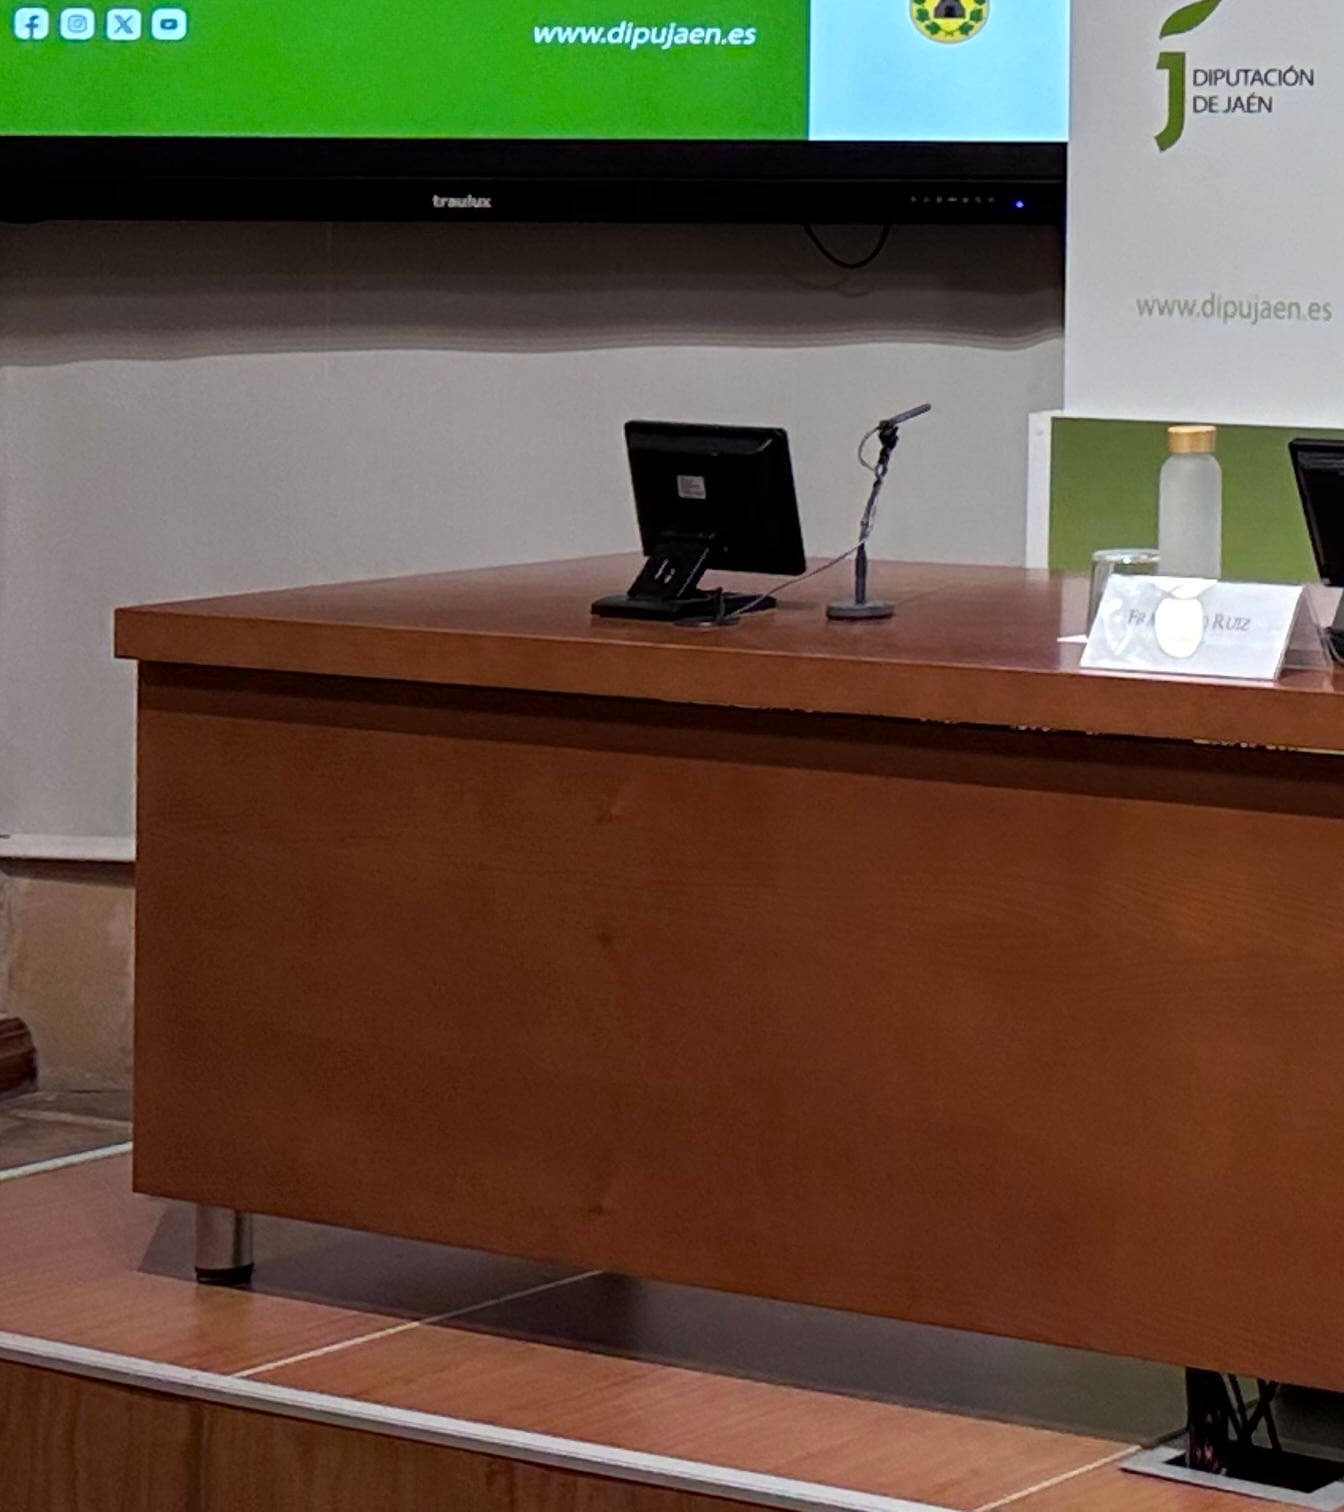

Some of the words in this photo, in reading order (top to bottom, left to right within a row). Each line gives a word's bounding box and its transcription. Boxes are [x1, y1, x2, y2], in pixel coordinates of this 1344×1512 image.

[533, 20, 757, 50] www.dipujaen.es
[1192, 65, 1315, 87] DIPUTACIÓN
[1192, 95, 1218, 114] DE
[1222, 93, 1273, 114] JAÉN
[1136, 292, 1332, 325] www.dipujaen.es
